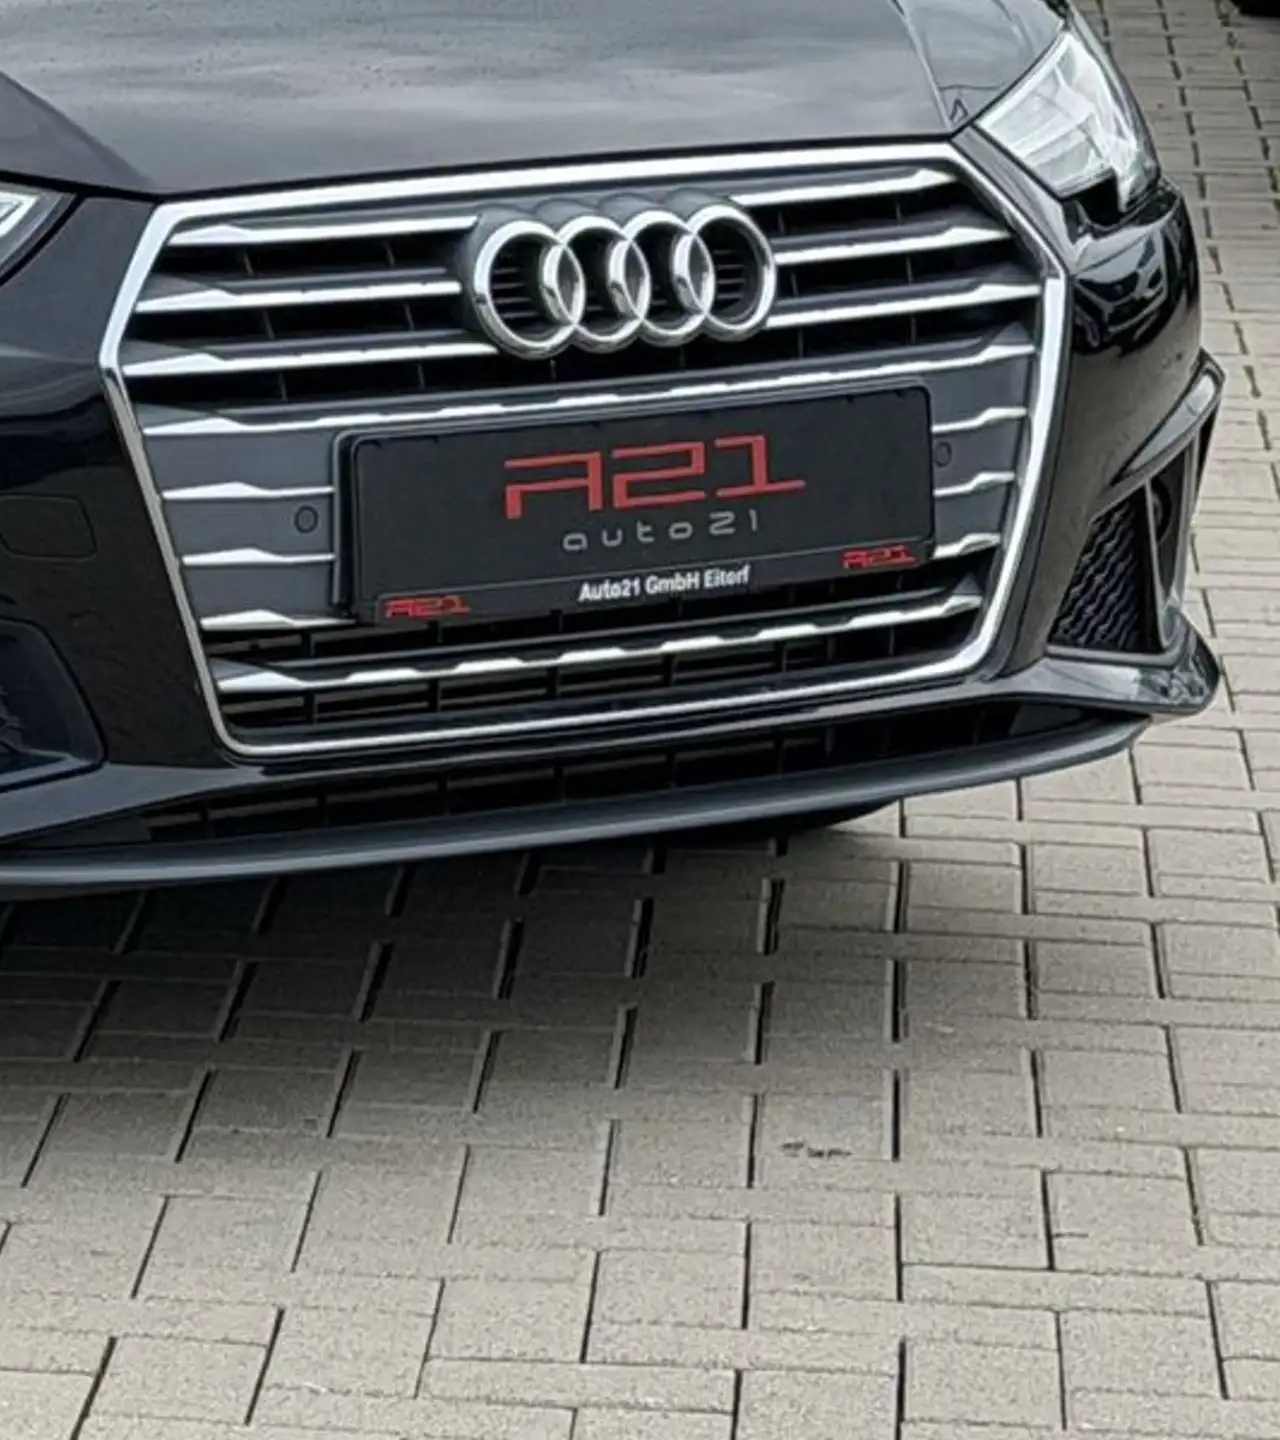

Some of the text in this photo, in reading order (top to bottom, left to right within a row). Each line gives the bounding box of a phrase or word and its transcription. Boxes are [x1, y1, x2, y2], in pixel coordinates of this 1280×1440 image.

[504, 434, 807, 520] A21
[561, 509, 760, 552] auto21
[843, 544, 917, 570] A21
[578, 563, 752, 603] Auto21 GmbH Eitorf
[384, 594, 472, 619] A21
